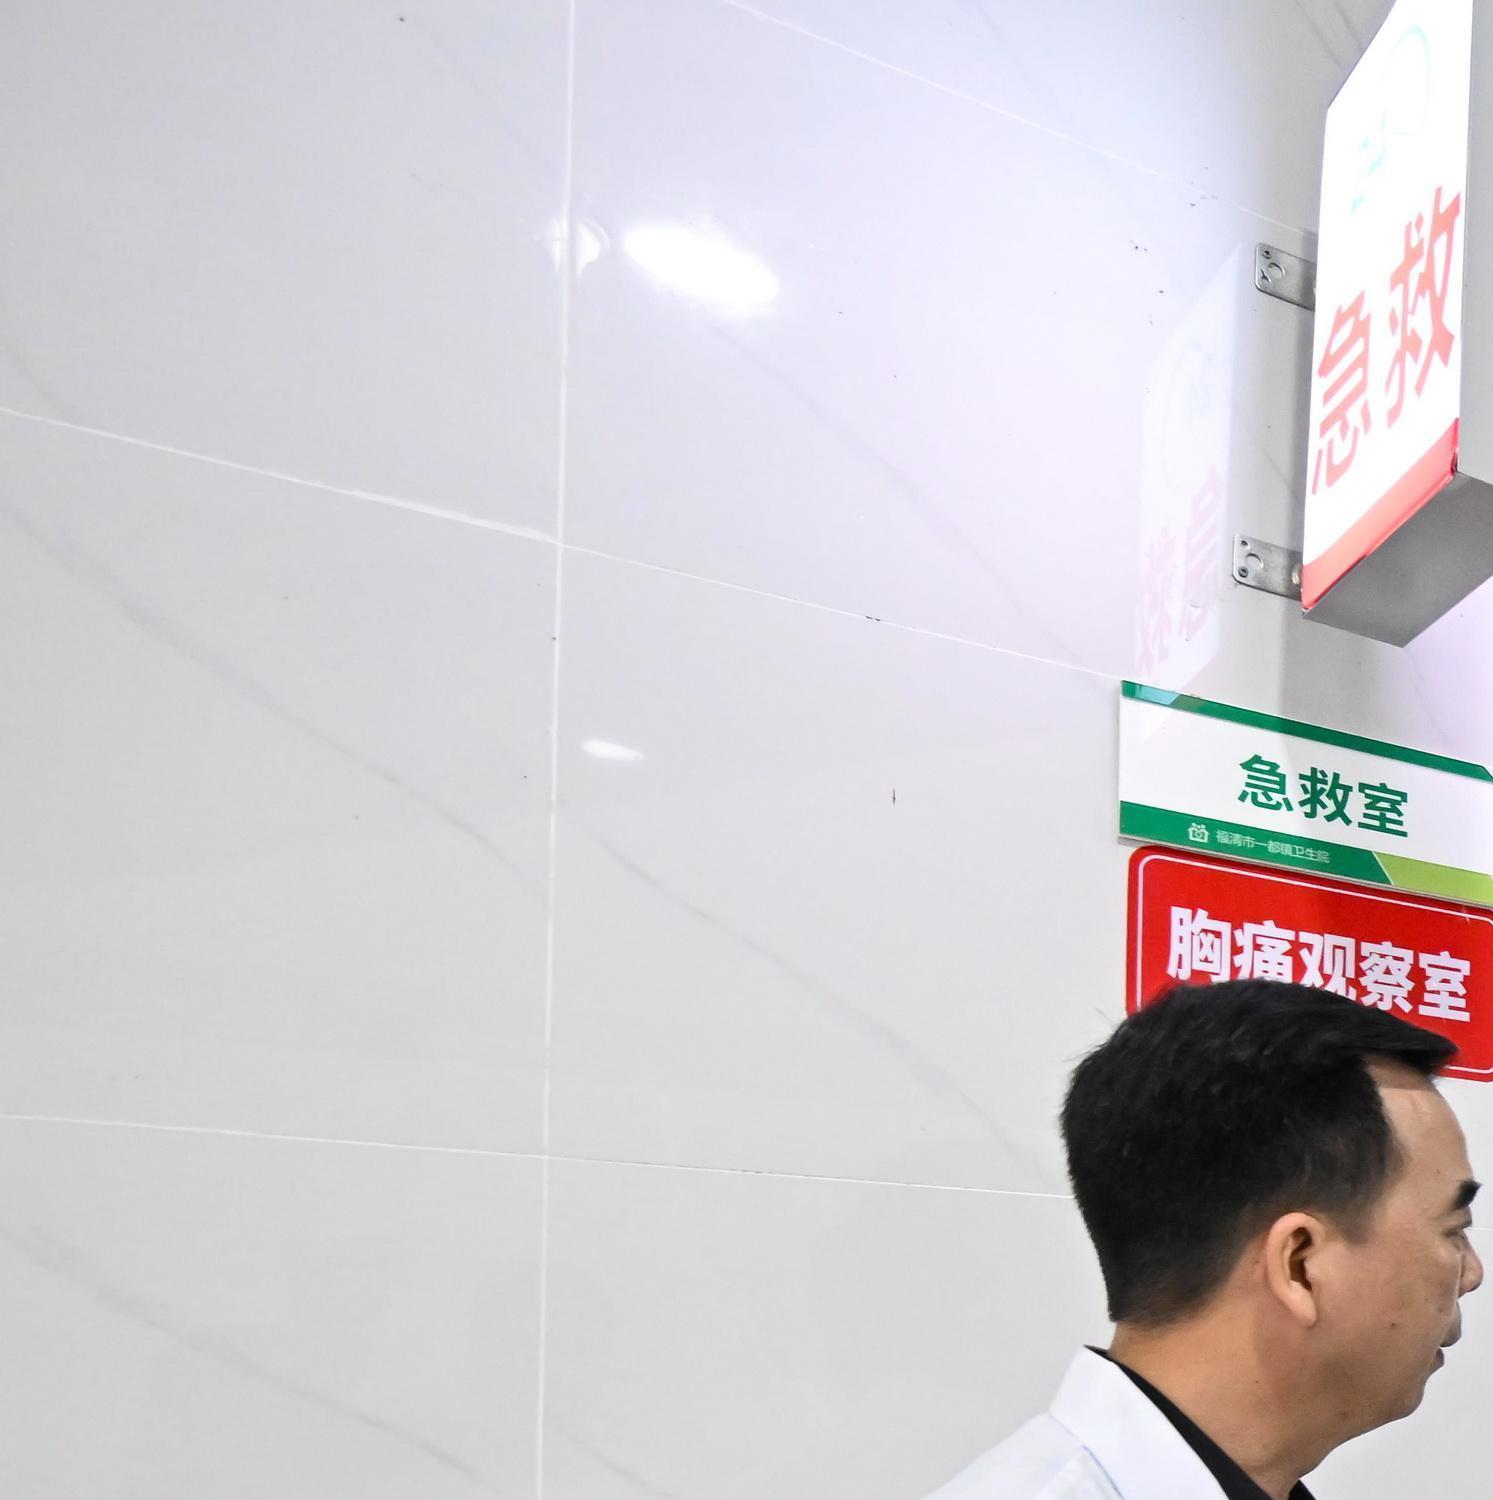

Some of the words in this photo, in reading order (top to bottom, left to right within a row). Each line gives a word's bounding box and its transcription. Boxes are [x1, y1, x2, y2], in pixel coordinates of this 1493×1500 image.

[1311, 186, 1462, 496] 急救
[1237, 753, 1409, 838] 急救室
[1166, 904, 1472, 1022] 胸痛观察室
